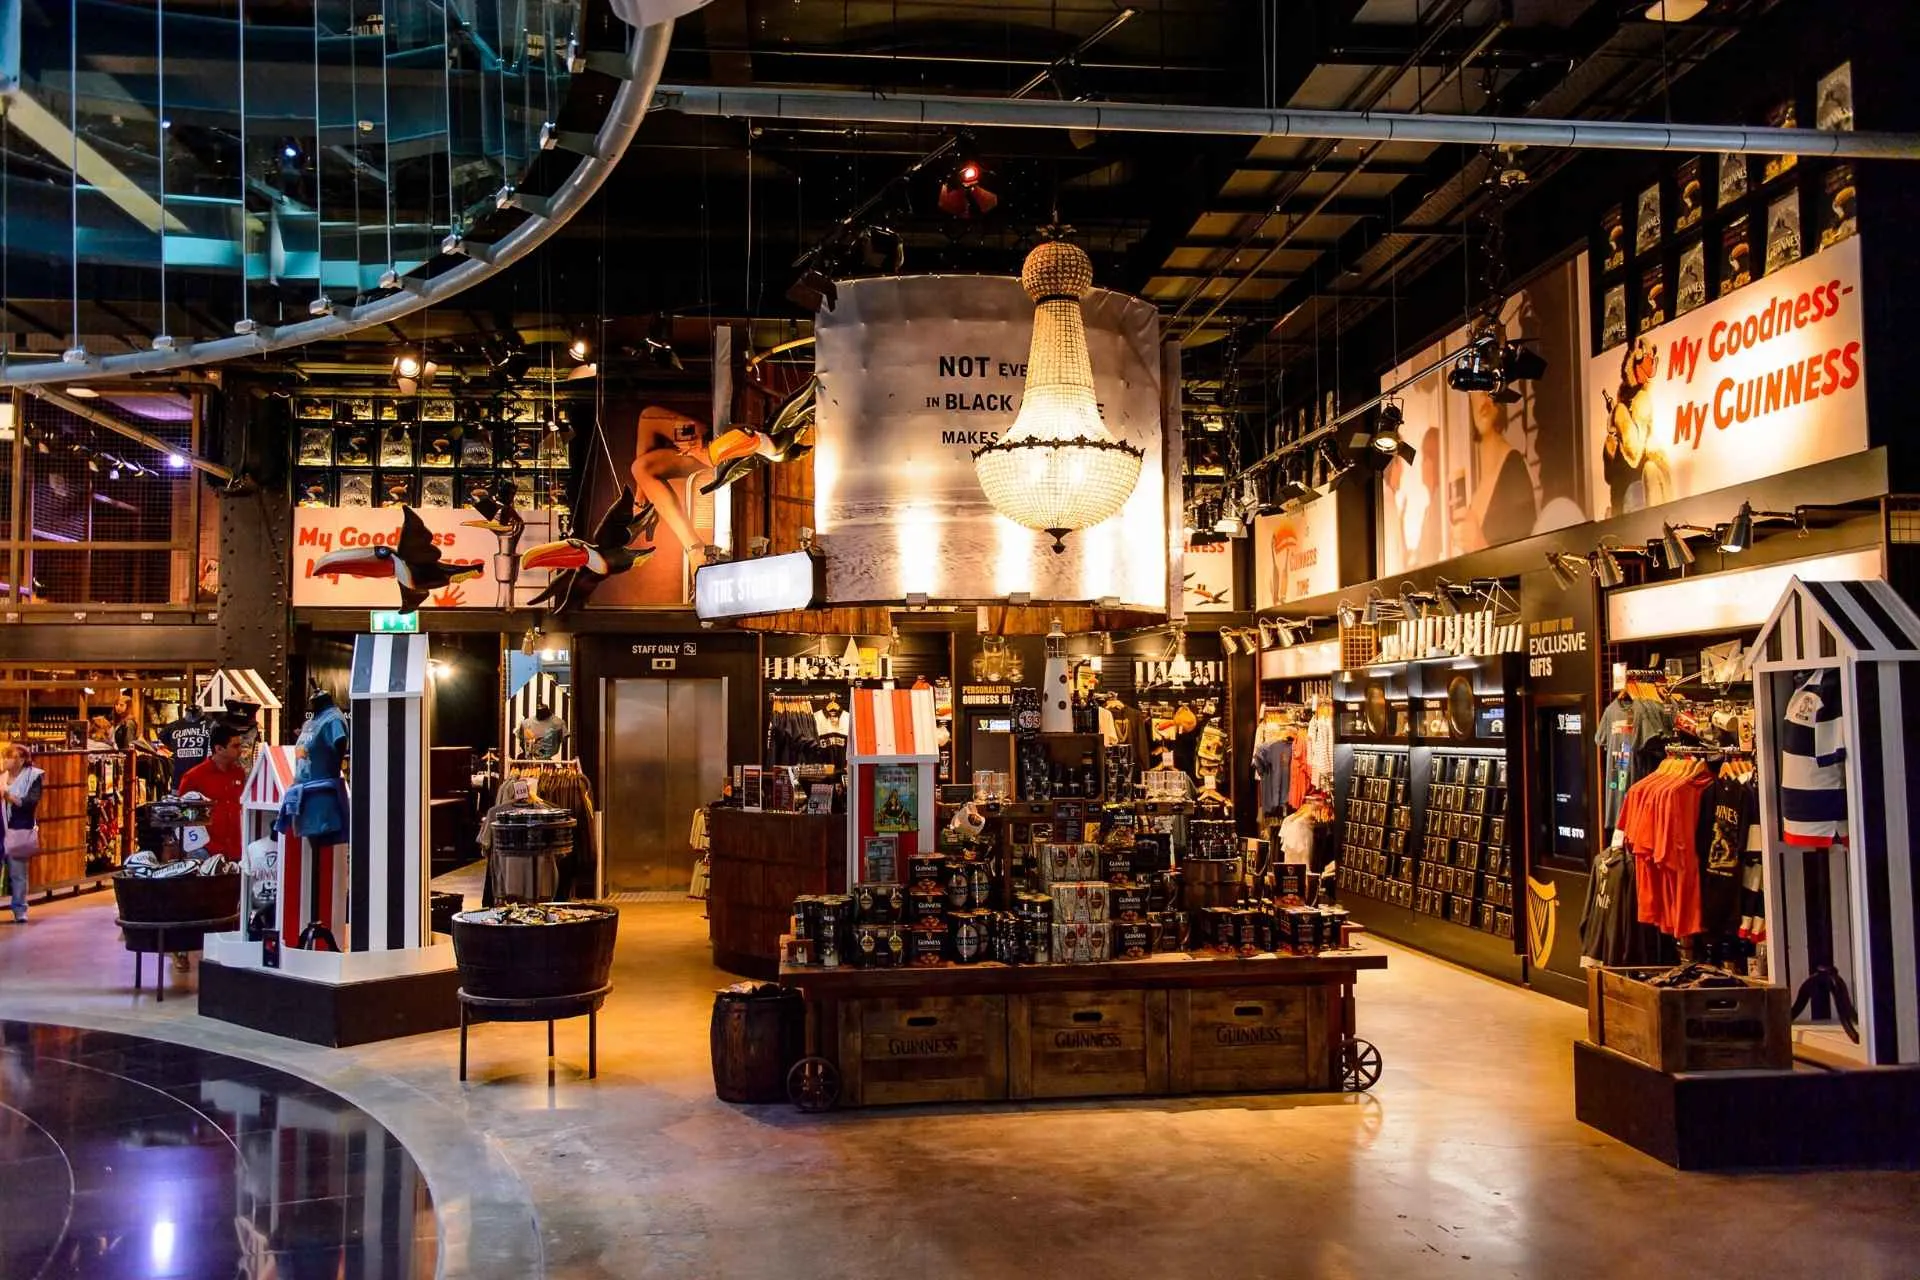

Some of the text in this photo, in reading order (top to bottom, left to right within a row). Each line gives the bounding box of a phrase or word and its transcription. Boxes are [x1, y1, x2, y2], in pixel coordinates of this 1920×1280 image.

[1667, 279, 1854, 384] My Goodness-
[939, 356, 991, 378] NOT
[926, 397, 940, 408] IN
[945, 394, 1014, 411] BLACK
[1673, 341, 1860, 450] My GUINNESS
[942, 431, 999, 444] MAKES
[299, 526, 456, 551] My Goodss
[712, 578, 734, 603] THE
[632, 645, 680, 654] STAFF ONLY
[1529, 631, 1587, 656] EXCLUSIVE
[1529, 657, 1552, 677] GIFTS
[962, 685, 1011, 694] PERSONALISED
[962, 694, 1000, 705] GUINNESS
[177, 736, 204, 748] 1759
[188, 830, 198, 842] 5
[1558, 826, 1571, 837] THE
[1055, 1031, 1121, 1049] GUINNESS
[1216, 1027, 1282, 1046] GUINNESS
[888, 1038, 959, 1056] GUINNESS
